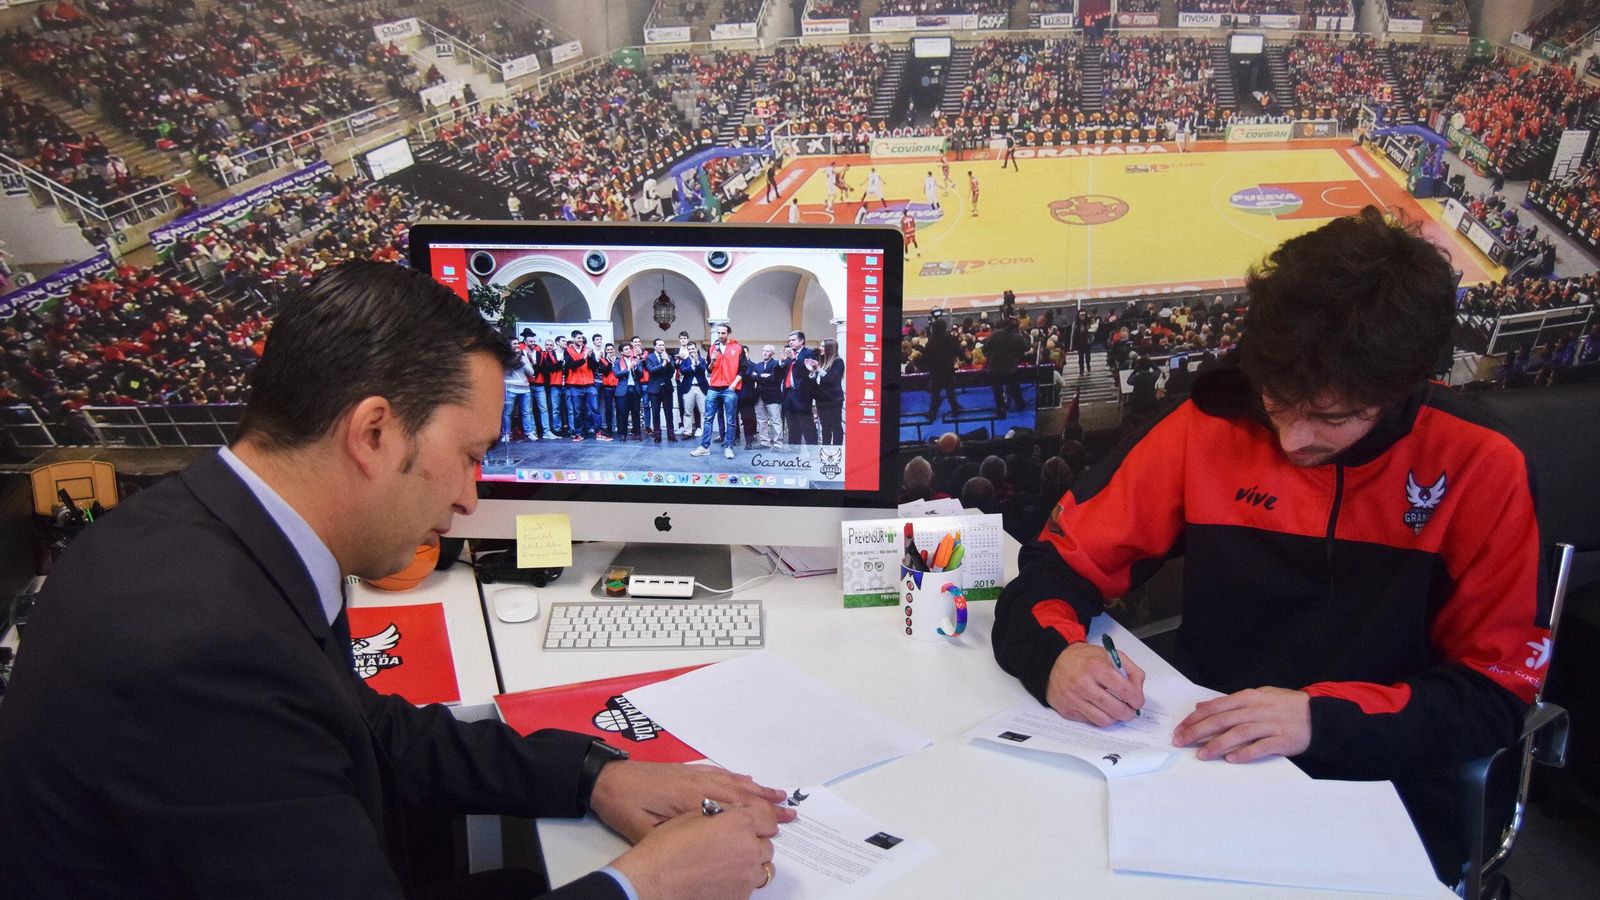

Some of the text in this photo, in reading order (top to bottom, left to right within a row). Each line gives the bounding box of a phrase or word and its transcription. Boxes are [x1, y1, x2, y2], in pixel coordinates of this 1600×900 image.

[1013, 144, 1169, 158] GRANADA
[1231, 193, 1297, 202] PULEVA
[988, 257, 1034, 266] COPA
[751, 453, 812, 468] Garnata
[1235, 486, 1278, 511] vive
[848, 528, 885, 545] PREVENSUR
[974, 580, 996, 589] 2019
